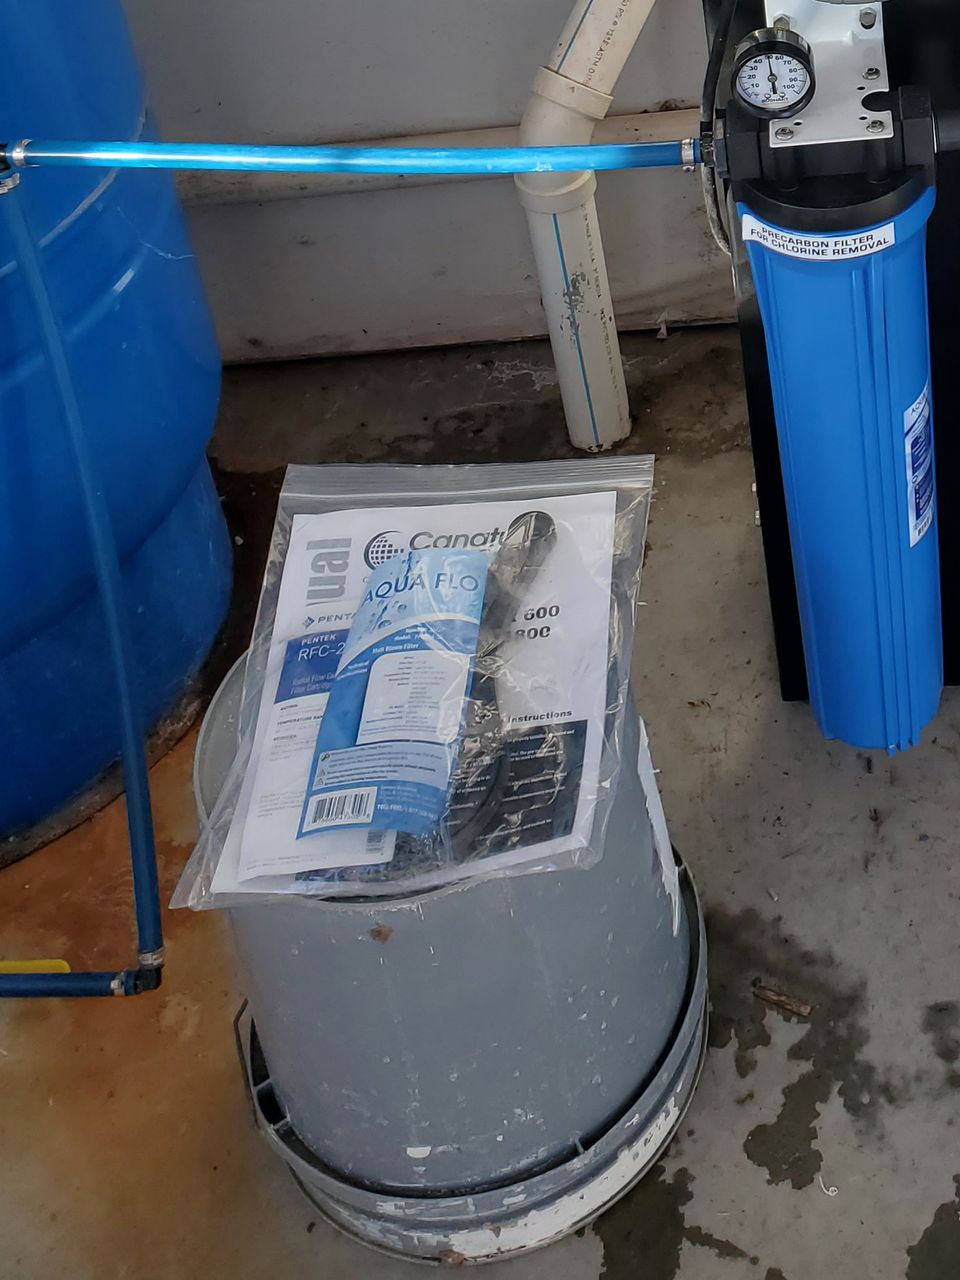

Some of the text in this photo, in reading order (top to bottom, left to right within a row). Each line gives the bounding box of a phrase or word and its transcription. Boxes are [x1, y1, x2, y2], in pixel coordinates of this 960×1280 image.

[750, 228, 889, 256] FOR CHLORINE REMOVAL
[762, 227, 874, 247] PRECARBON FILTER
[364, 572, 479, 603] AQUA FLO
[317, 613, 353, 624] PENT
[524, 605, 560, 621] 600
[301, 634, 337, 646] PENTEK
[404, 643, 418, 651] Filter
